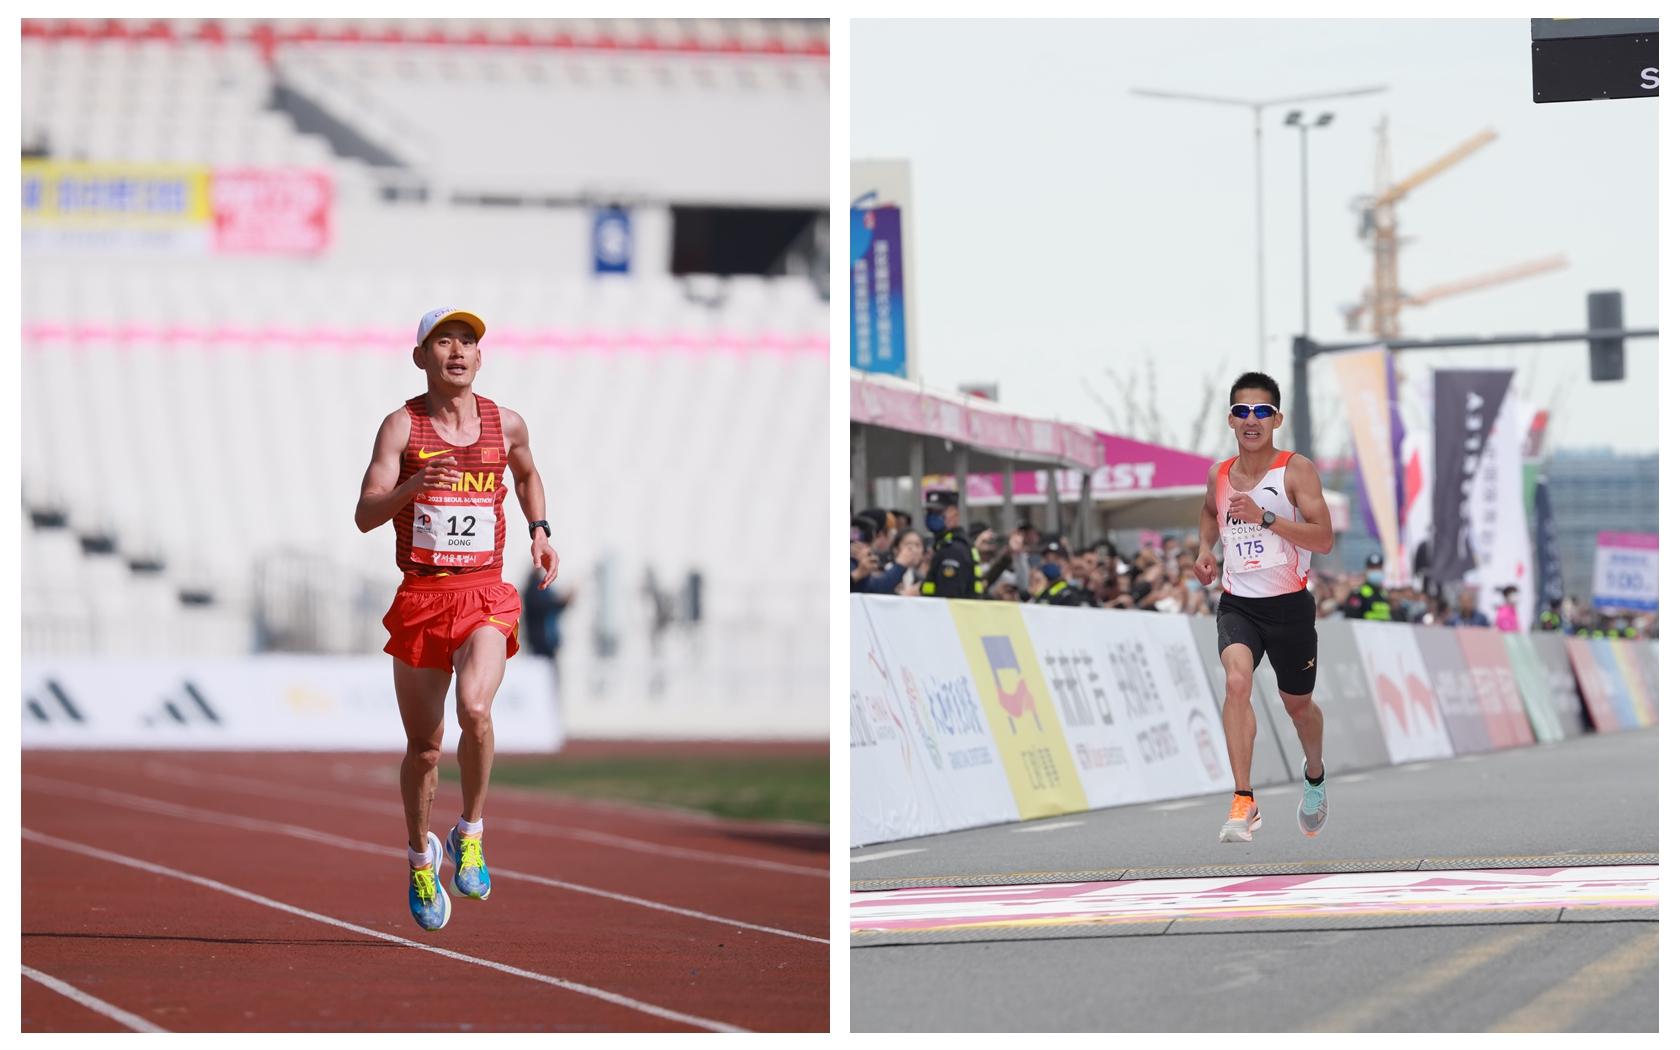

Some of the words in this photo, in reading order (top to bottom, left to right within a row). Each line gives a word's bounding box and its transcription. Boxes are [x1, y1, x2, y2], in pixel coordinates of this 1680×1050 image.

[447, 515, 476, 536] 12
[1231, 525, 1263, 535] COLMO
[1235, 540, 1264, 556] 175
[441, 554, 477, 563] 서울특별시
